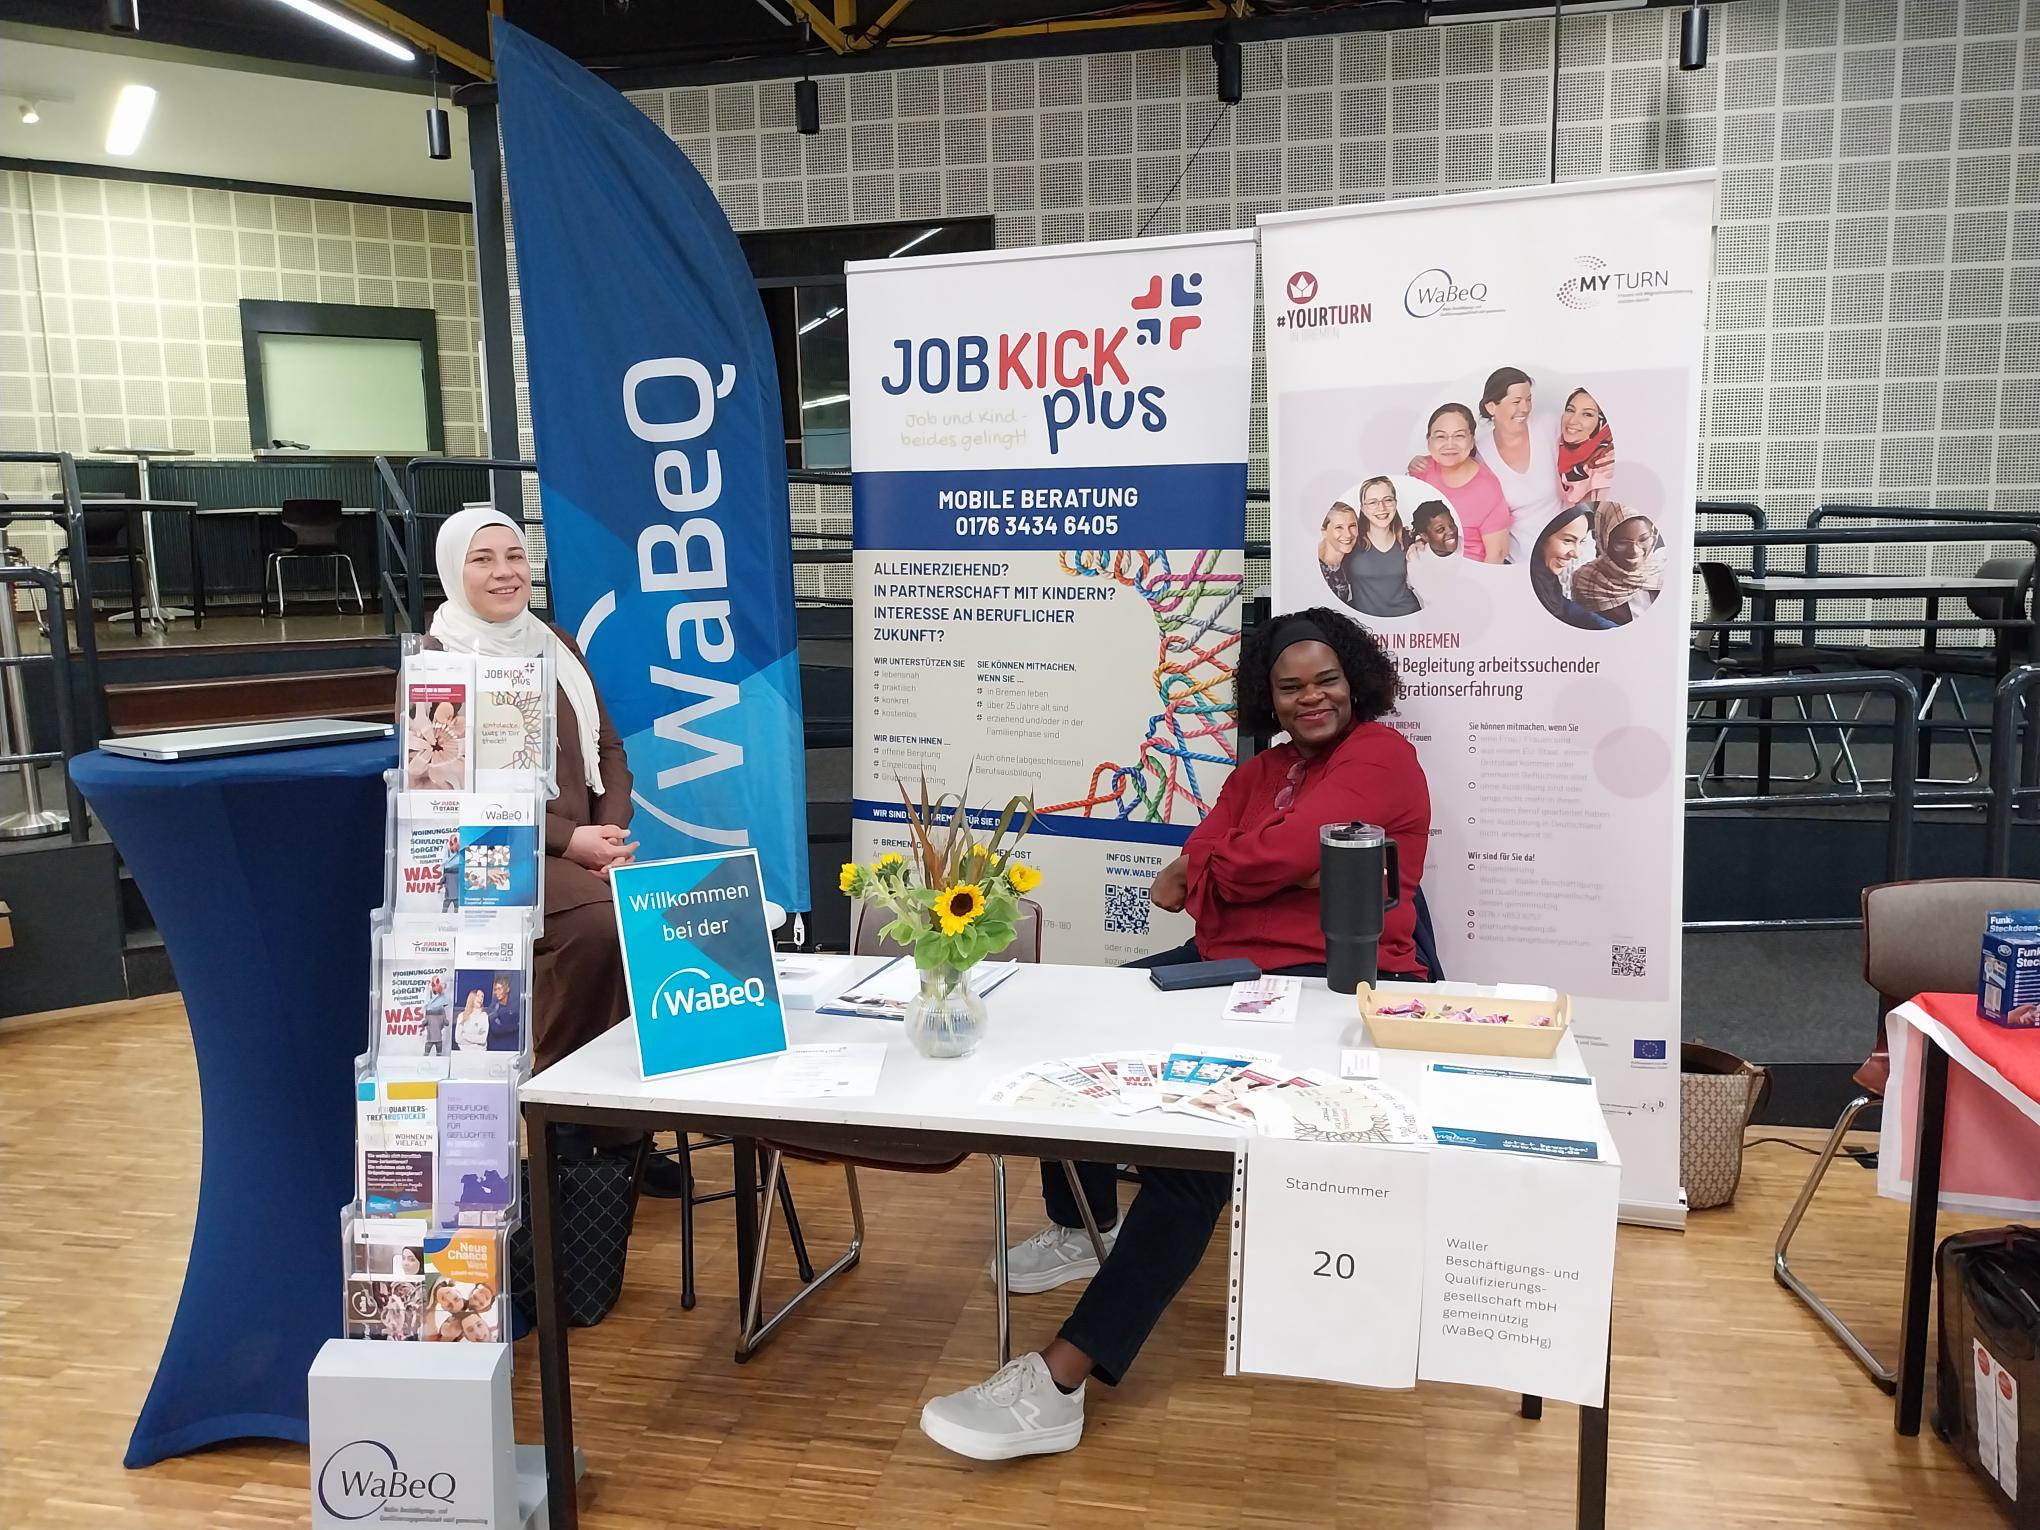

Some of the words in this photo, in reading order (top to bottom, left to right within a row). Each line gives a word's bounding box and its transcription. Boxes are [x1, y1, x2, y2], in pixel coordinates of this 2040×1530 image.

[1418, 282, 1488, 304] WaBeQ
[1277, 303, 1372, 329] #YOURTURN
[904, 409, 938, 428] Job
[942, 409, 974, 426] und
[979, 407, 1017, 425] Kind
[1042, 373, 1168, 455] plus
[900, 431, 957, 448] beides
[938, 489, 1015, 511] MOBILE
[1021, 487, 1138, 509] BERATUNG
[956, 516, 1000, 536] 0176
[1005, 515, 1058, 536] 3434
[1064, 514, 1119, 535] 6405
[623, 357, 745, 790] WaBeQ
[874, 562, 1010, 577] ALLEINERZIEHEND?
[874, 585, 887, 597] IN
[890, 585, 1010, 600] PARTNERSCHAFT
[1014, 586, 1039, 600] MIT
[1042, 586, 1116, 601] KINDERN?
[874, 606, 949, 621] INTERESSE
[953, 608, 973, 621] AN
[976, 608, 1075, 624] BERUFLICHER
[874, 628, 945, 643] ZUKUNFT?
[1393, 633, 1406, 649] IN
[1410, 632, 1461, 649] BREMEN
[873, 657, 888, 665] WIR
[889, 656, 952, 667] UNTERSTÜTZEN
[953, 659, 966, 668] SIE
[977, 660, 990, 669] SIE
[991, 659, 1025, 670] KÖNNEN
[1026, 662, 1077, 672] MITMACHEN,
[1402, 656, 1475, 677] Begleitung
[1478, 656, 1601, 674] arbeitssuchender
[977, 674, 1001, 682] WENN
[1002, 675, 1016, 683] SIE
[987, 688, 994, 696] in
[996, 688, 1026, 697] Bremen
[1028, 689, 1049, 698] leben
[1006, 701, 1016, 710] 25
[1052, 704, 1069, 713] sind
[1070, 718, 1084, 727] der
[1469, 722, 1479, 731] Sie
[1480, 721, 1505, 731] können
[1507, 722, 1547, 733] mitmachen,
[1548, 723, 1564, 732] wenn
[1565, 723, 1579, 732] Sie
[873, 734, 888, 742] WIR
[889, 735, 917, 744] BIETEN
[918, 736, 943, 745] IHNEN
[1043, 730, 1061, 739] sind
[1410, 733, 1432, 742] Frauen
[976, 752, 996, 762] Auch
[996, 754, 1015, 763] ohne
[485, 810, 522, 822] WaBeQ
[873, 808, 887, 818] WIR
[888, 809, 907, 819] SIND
[981, 817, 994, 826] SIE
[1106, 852, 1132, 863] INFOS
[1133, 855, 1162, 865] UNTER
[1468, 851, 1482, 861] Wir
[1482, 852, 1498, 861] sind
[1499, 852, 1510, 862] für
[1511, 853, 1523, 862] Sie
[1524, 853, 1536, 862] da!
[404, 864, 443, 881] WAS
[1106, 866, 1159, 878] WWW.WABE
[406, 882, 444, 893] NUN?
[629, 884, 750, 912] Willkommen
[663, 921, 693, 942] bei
[697, 917, 729, 937] der
[1124, 945, 1132, 953] in
[1133, 946, 1149, 955] den
[664, 977, 765, 1017] WaBeQ
[385, 1007, 424, 1023] WAS
[387, 1024, 426, 1036] NUN?
[1285, 1177, 1391, 1199] Standnummer
[460, 1242, 488, 1252] Neue
[1446, 1238, 1488, 1252] Waller
[447, 1250, 488, 1260] Chance
[1312, 1250, 1355, 1280] 20
[1553, 1269, 1579, 1281] und
[1444, 1272, 1547, 1294] Qualifizierungs-
[1443, 1291, 1522, 1308] gesellschaft
[1525, 1299, 1558, 1313] mbH
[1442, 1324, 1495, 1340] (WaBeQ
[1497, 1329, 1552, 1349] GmbHg)
[341, 1471, 457, 1504] WaBeQ
